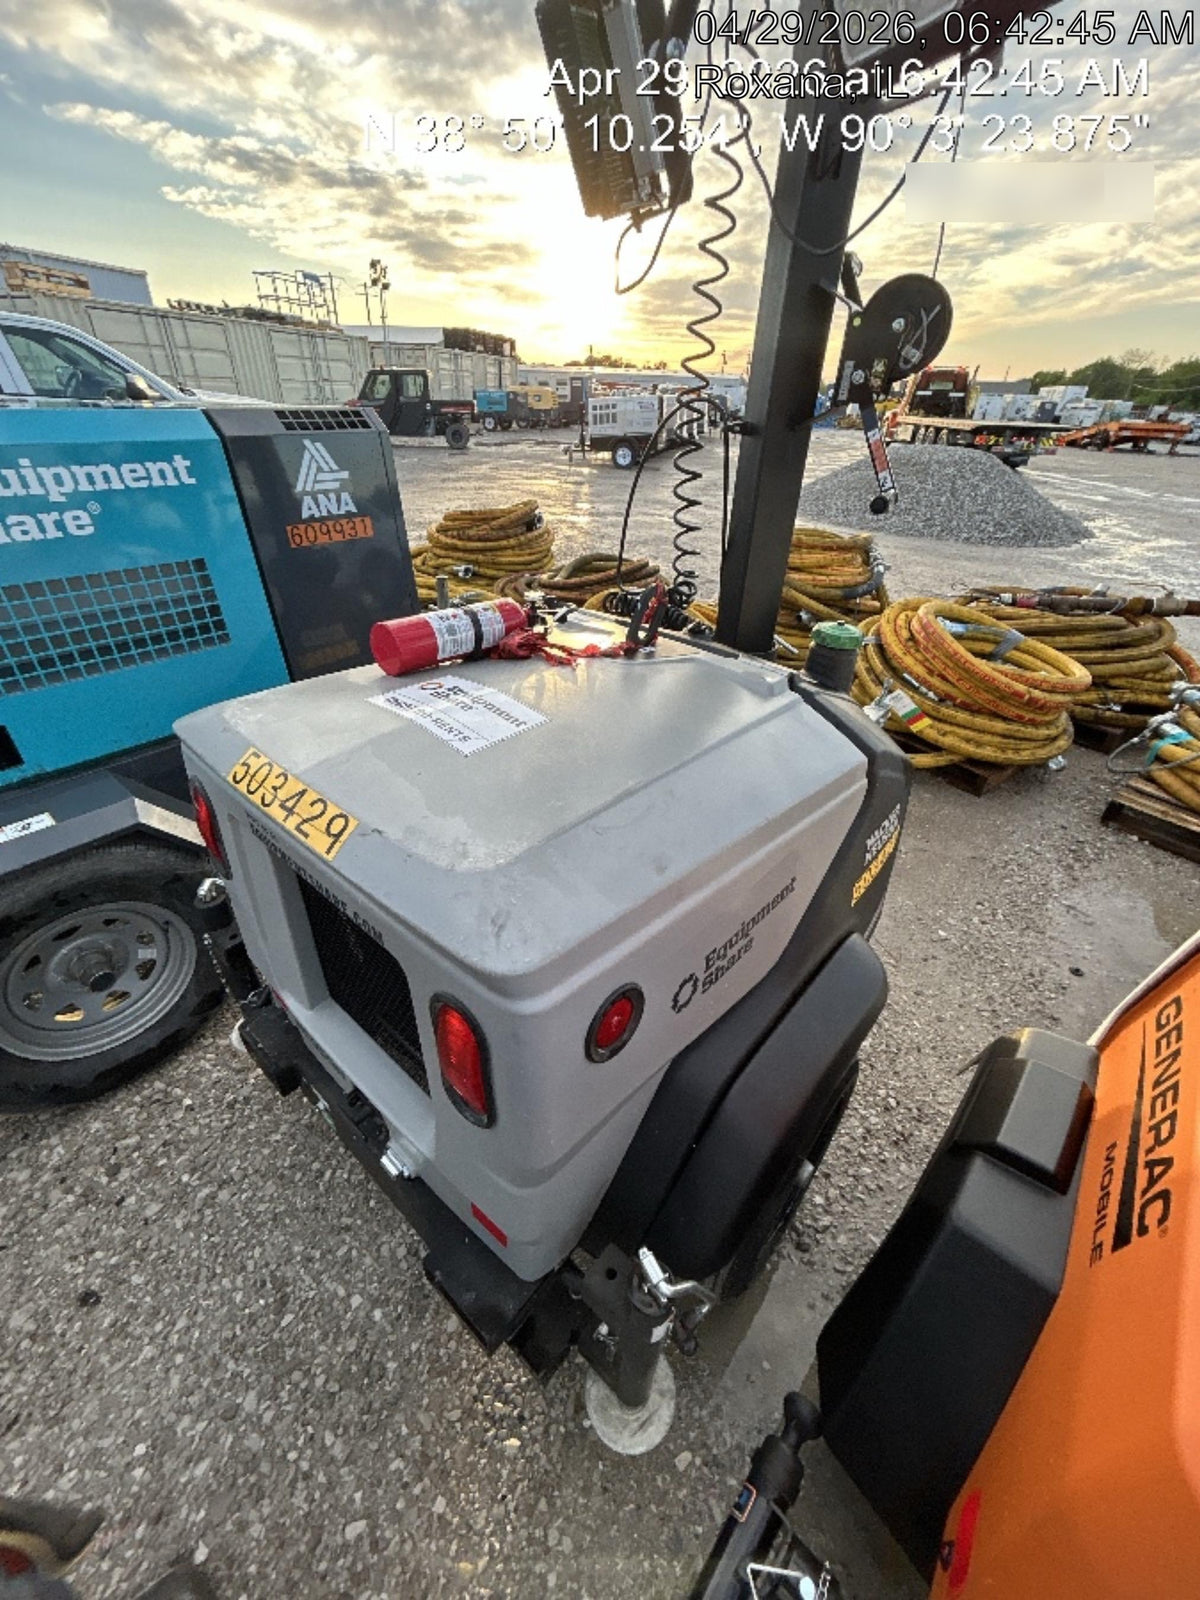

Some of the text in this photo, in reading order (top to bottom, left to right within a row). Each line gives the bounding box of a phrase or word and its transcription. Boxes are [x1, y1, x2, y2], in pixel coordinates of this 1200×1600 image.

[290, 518, 368, 547] 609931
[302, 491, 358, 519] ANA
[232, 751, 350, 856] 503429
[703, 876, 797, 975] Equipment
[700, 937, 755, 994] Share
[1089, 1140, 1117, 1268] MOBILE
